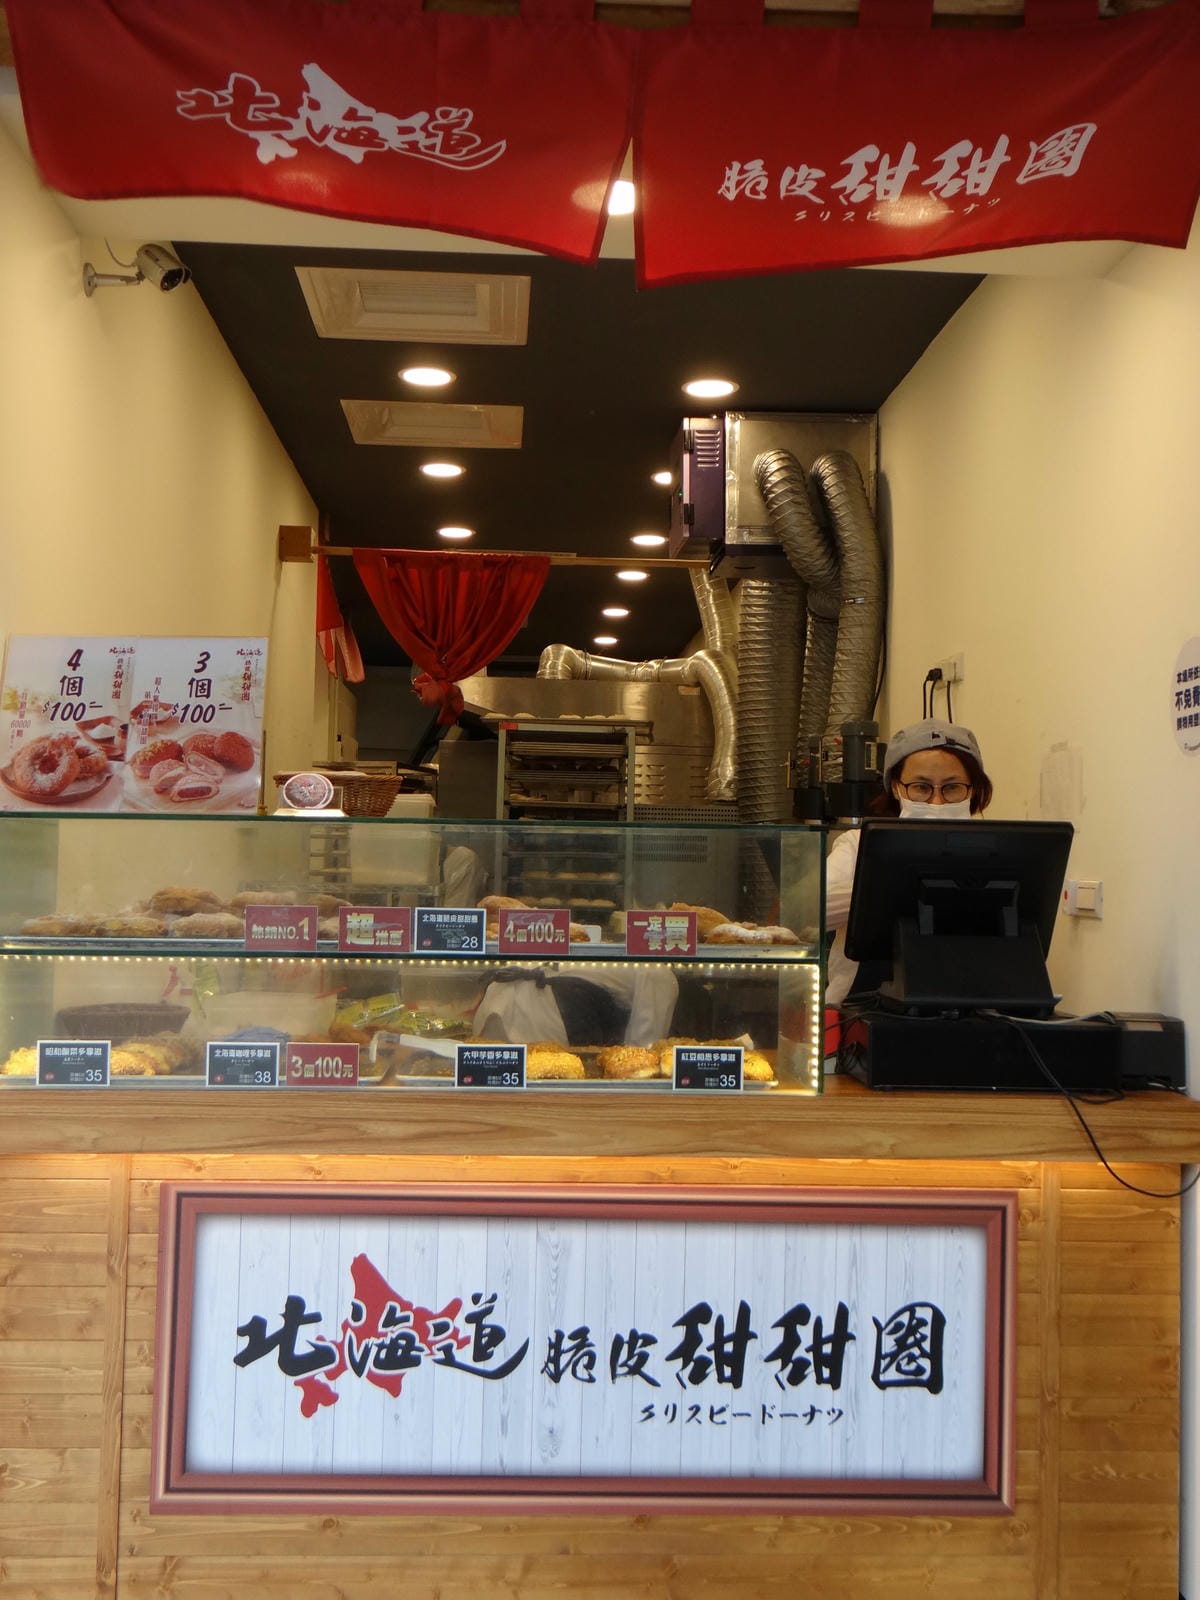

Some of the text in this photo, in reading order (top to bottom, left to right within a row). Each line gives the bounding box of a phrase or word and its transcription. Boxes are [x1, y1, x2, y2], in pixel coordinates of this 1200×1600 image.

[175, 68, 507, 171] 北海道
[717, 122, 1097, 204] 脆皮甜甜圈
[461, 935, 479, 949] 28
[290, 1055, 355, 1080] 3個100元
[85, 1068, 103, 1082] 35
[254, 1070, 272, 1083] 38
[502, 1072, 519, 1085] 35
[719, 1074, 737, 1087] 35
